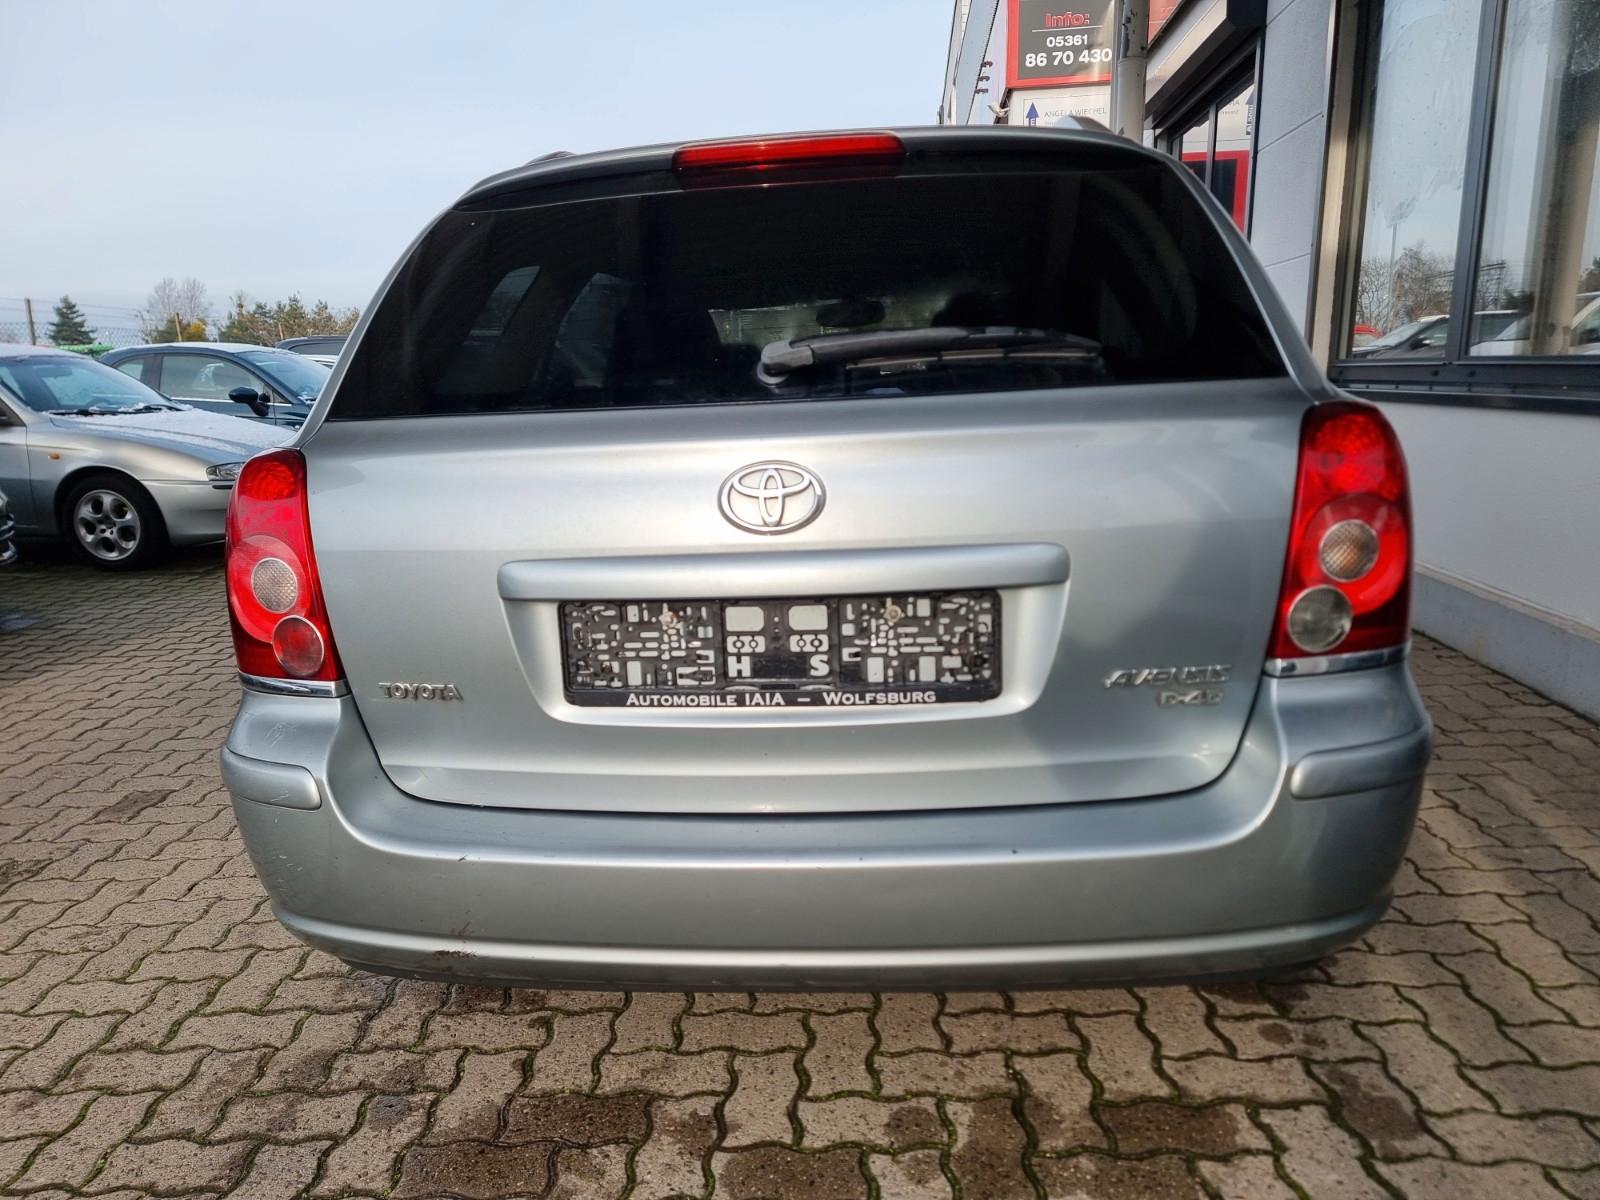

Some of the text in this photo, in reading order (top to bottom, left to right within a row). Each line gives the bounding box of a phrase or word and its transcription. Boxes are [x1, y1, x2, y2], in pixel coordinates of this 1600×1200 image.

[1045, 11, 1090, 28] Info:
[1046, 34, 1088, 47] 05361
[1025, 48, 1113, 67] 86 70 430
[378, 682, 464, 701] TOYOTA
[745, 692, 785, 706] IAIA
